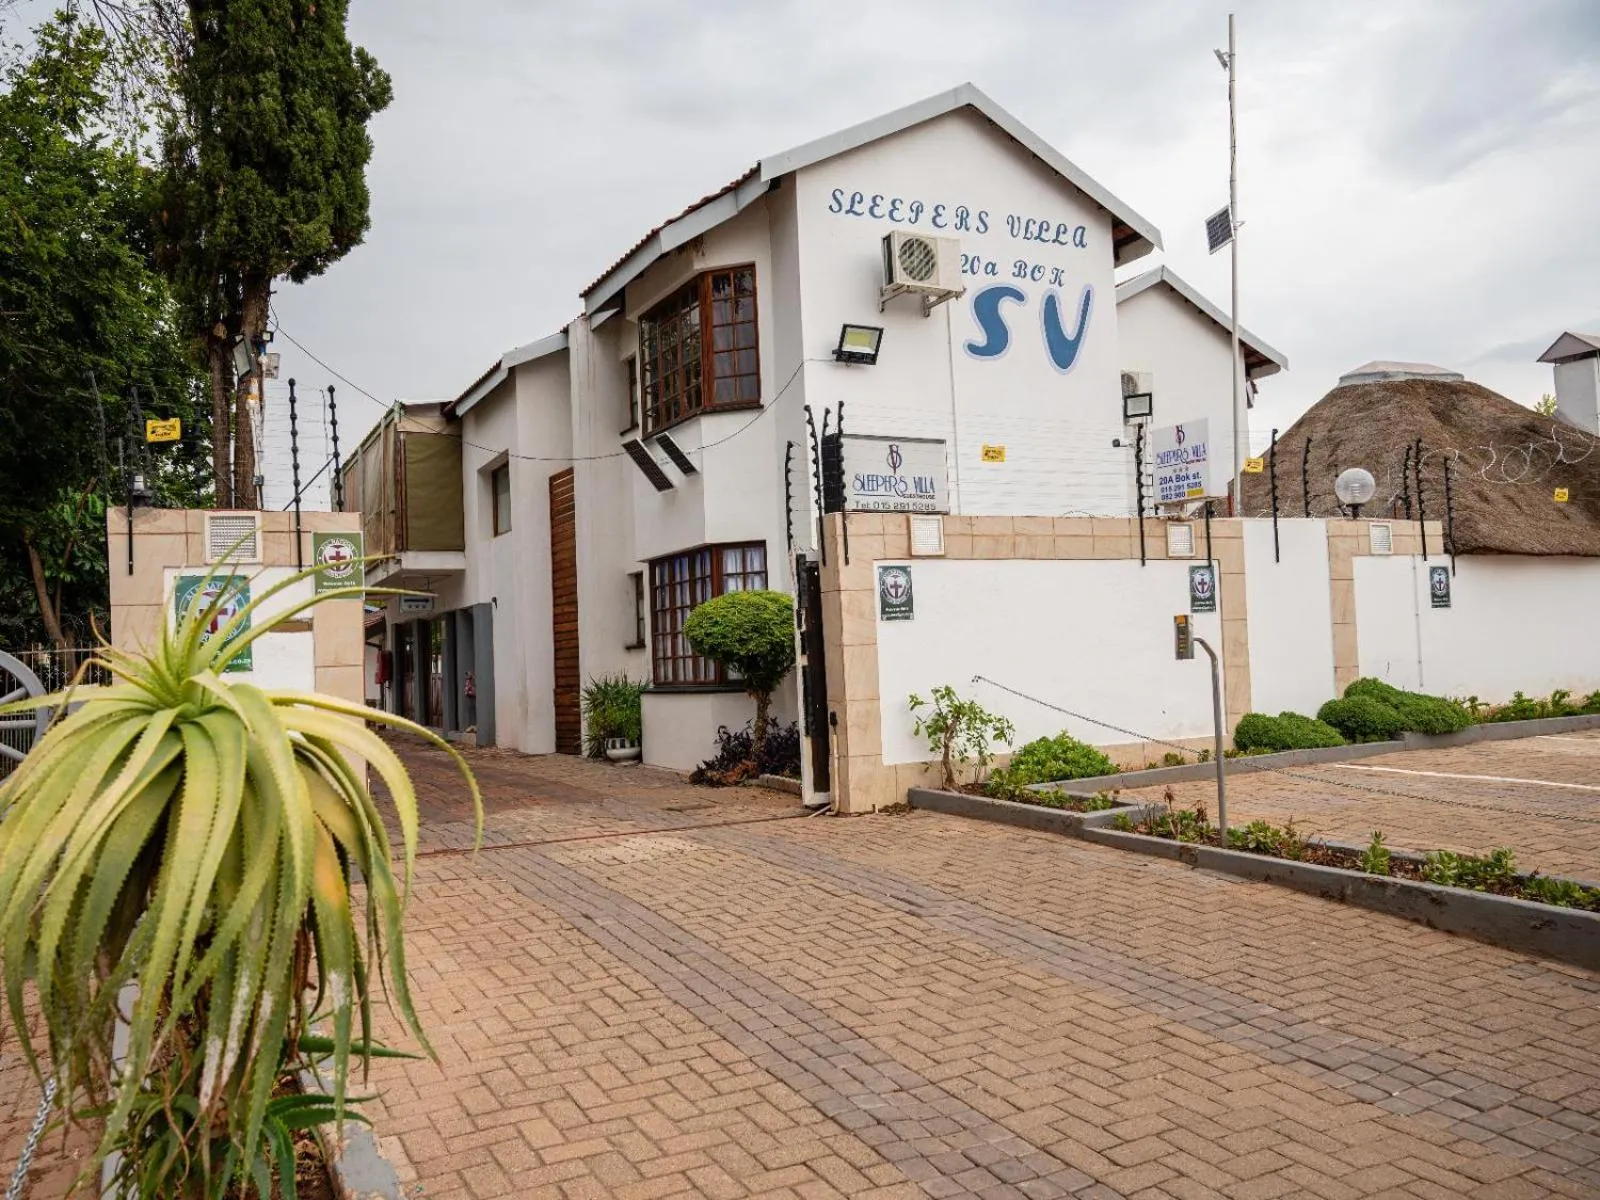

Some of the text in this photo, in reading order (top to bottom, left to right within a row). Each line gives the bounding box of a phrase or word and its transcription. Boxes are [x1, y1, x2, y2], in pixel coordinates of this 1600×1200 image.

[828, 188, 990, 235] SLEEPERS
[1012, 259, 1065, 288] BOK
[852, 473, 935, 495] SLEEPERS VILLA
[1159, 476, 1174, 485] 20A
[1175, 473, 1190, 482] Bok
